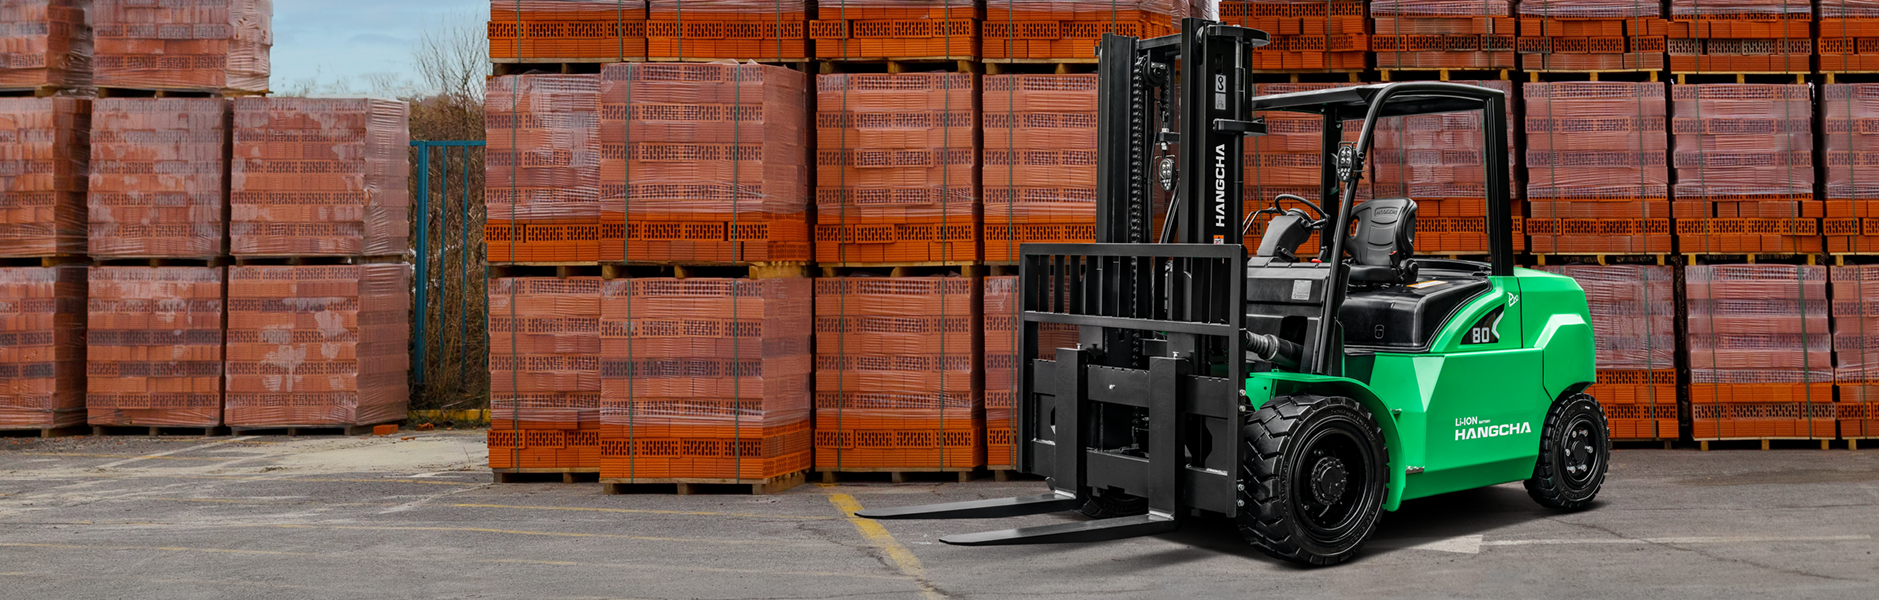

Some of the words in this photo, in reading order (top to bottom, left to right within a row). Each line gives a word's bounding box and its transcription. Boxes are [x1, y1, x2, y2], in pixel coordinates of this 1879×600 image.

[1215, 143, 1225, 227] HANGCHA
[1472, 327, 1490, 343] 80
[1455, 422, 1531, 441] HANGCHA
